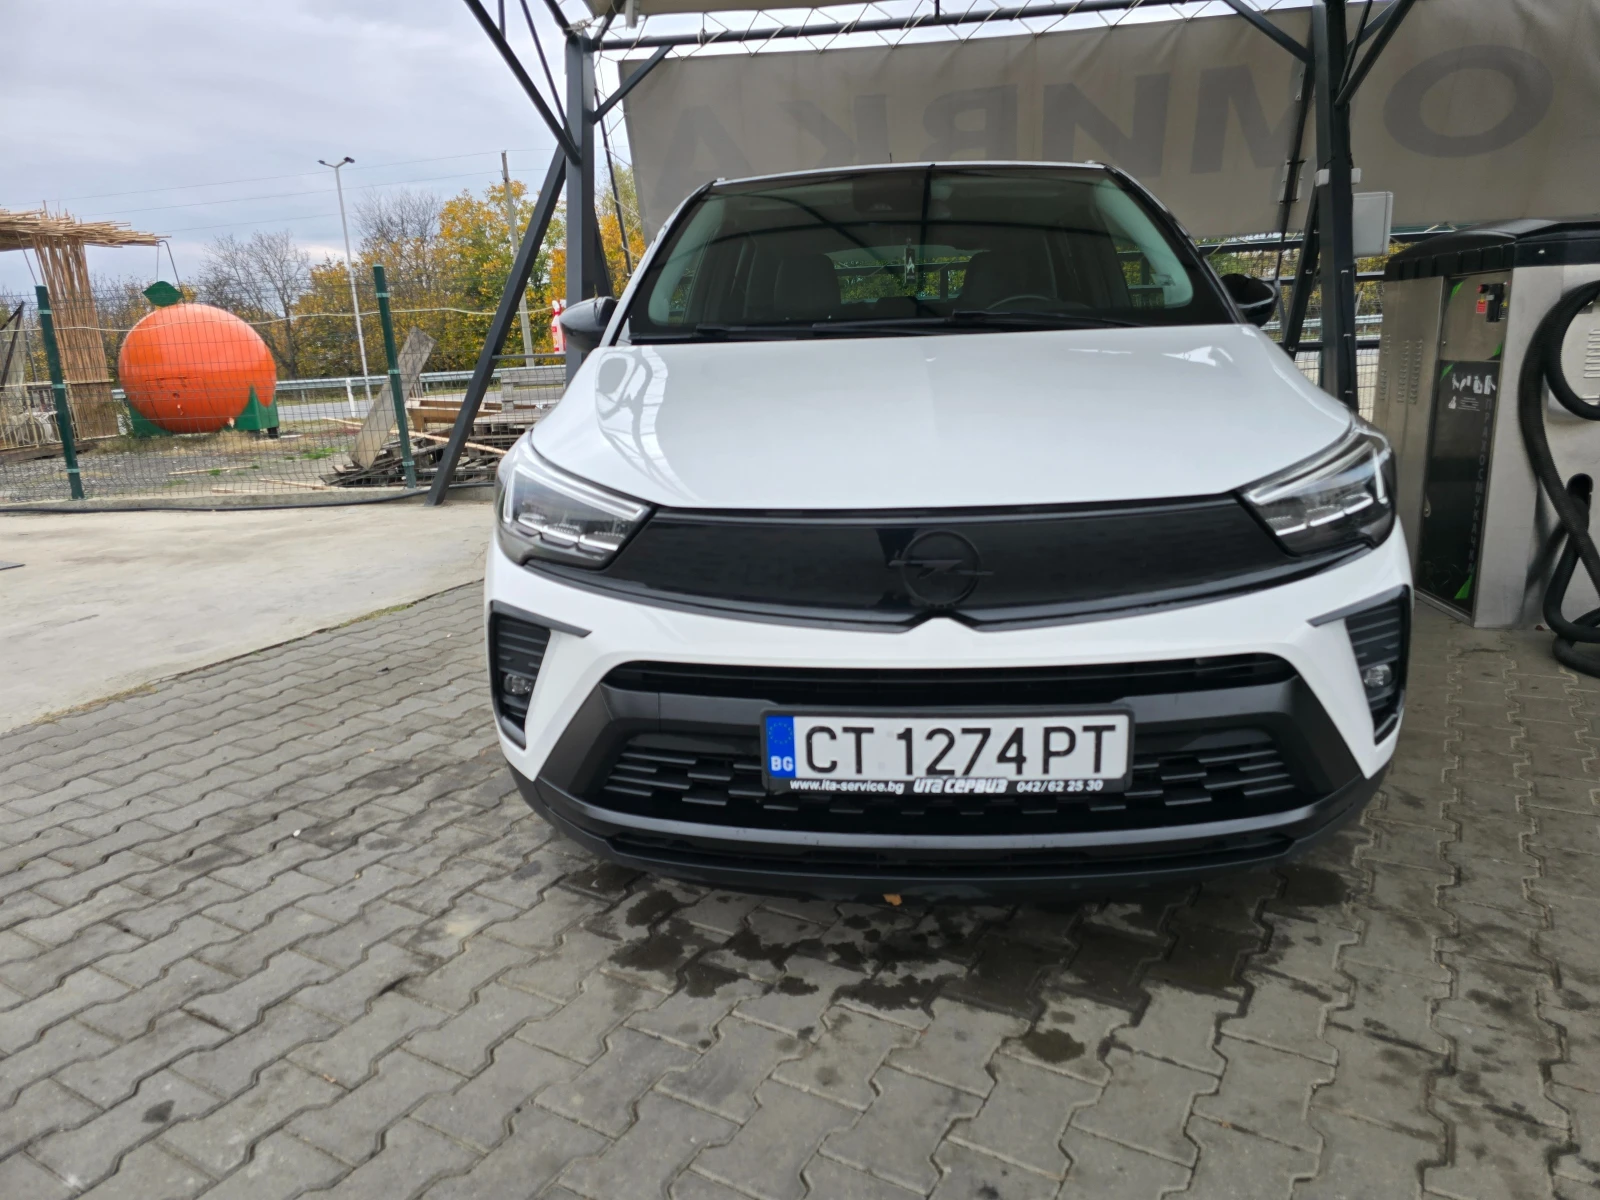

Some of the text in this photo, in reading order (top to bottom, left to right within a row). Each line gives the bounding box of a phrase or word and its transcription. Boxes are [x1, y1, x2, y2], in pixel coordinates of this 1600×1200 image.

[805, 724, 1116, 776] CT 1274 PT
[770, 755, 794, 772] BG
[789, 779, 905, 795] www.ita-service.bg
[1086, 779, 1104, 792] 30
